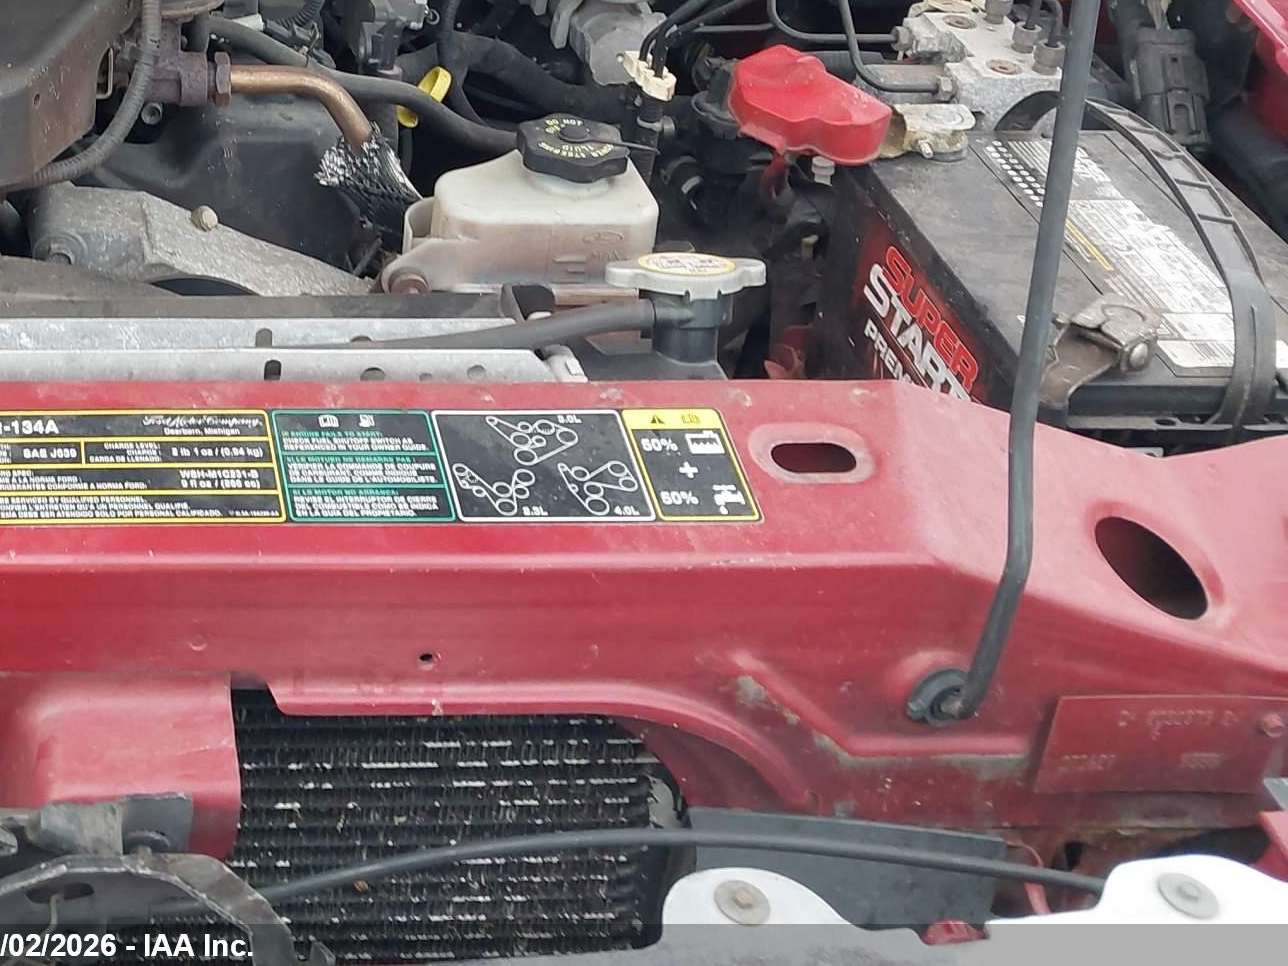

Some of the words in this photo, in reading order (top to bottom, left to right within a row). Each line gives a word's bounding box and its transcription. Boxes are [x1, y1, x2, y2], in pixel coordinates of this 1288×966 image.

[562, 118, 584, 126] NOT
[882, 246, 978, 394] SUPER
[864, 263, 971, 402] START
[641, 438, 678, 452] 50%
[23, 448, 47, 458] SAE
[661, 491, 699, 505] 50%
[614, 506, 640, 516] 4.0L
